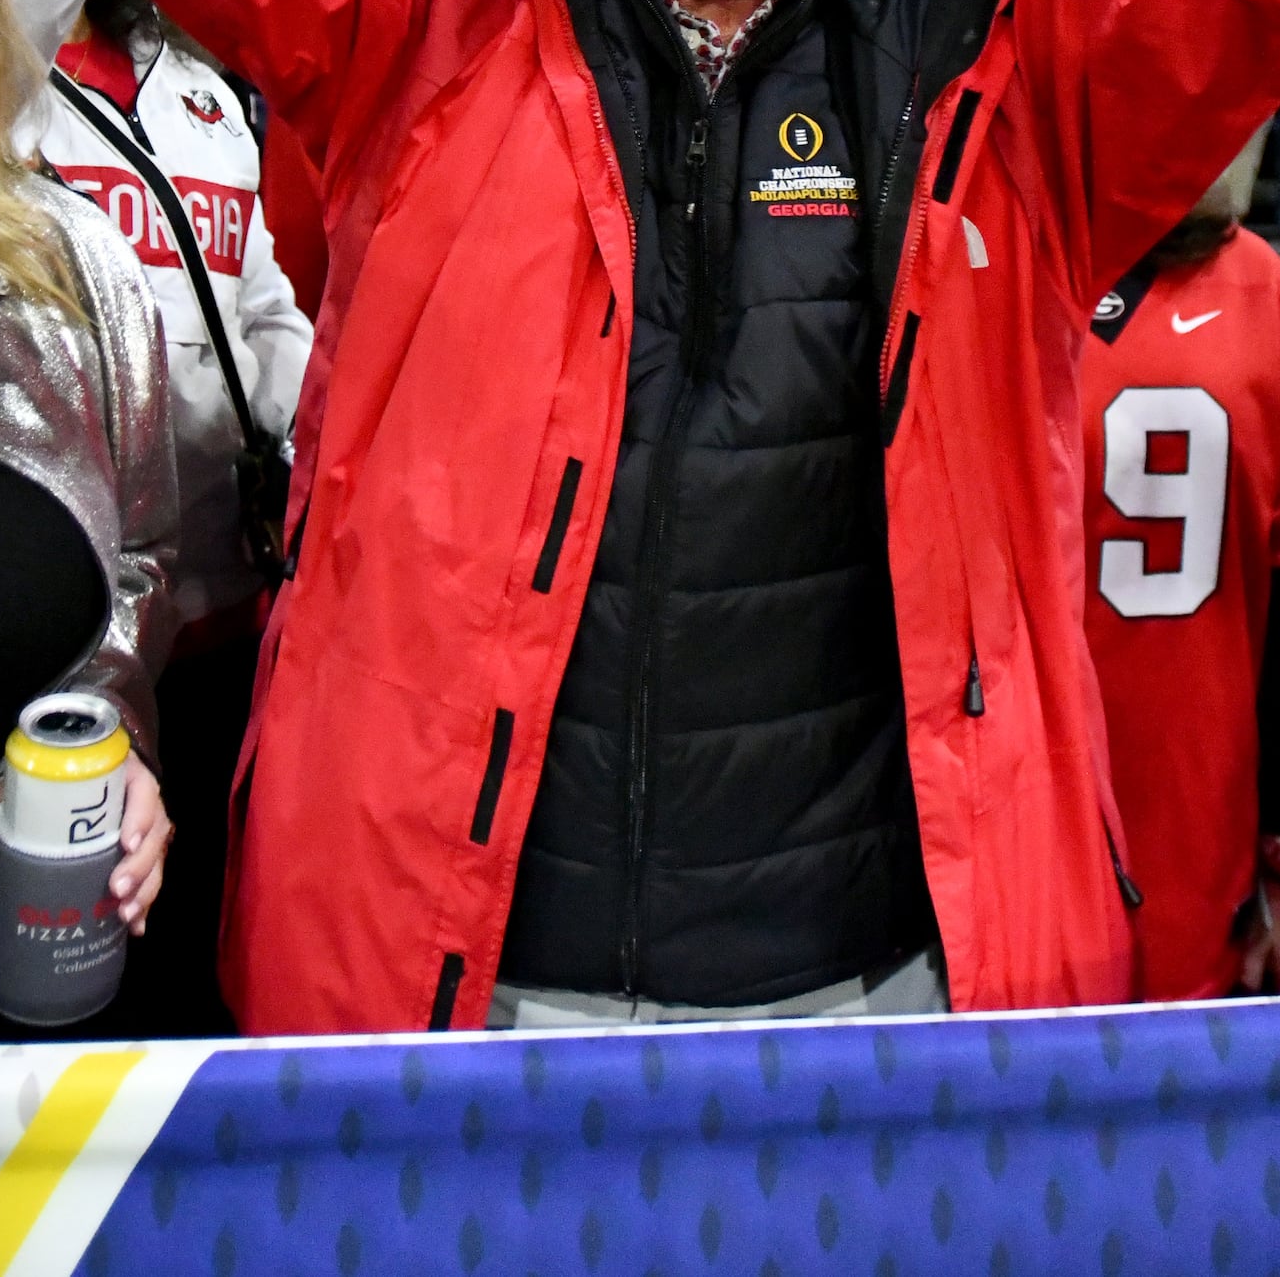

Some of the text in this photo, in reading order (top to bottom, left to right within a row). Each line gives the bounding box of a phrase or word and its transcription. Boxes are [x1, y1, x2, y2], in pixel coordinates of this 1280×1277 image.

[772, 165, 841, 180] NATIONAL
[759, 177, 856, 192] CHAMPIONSHIP
[750, 188, 837, 202] INDIANAPOLIS
[767, 203, 849, 217] GEORGIA
[70, 179, 244, 261] ORGIA
[1099, 386, 1230, 618] 9
[17, 923, 86, 942] PIZZA
